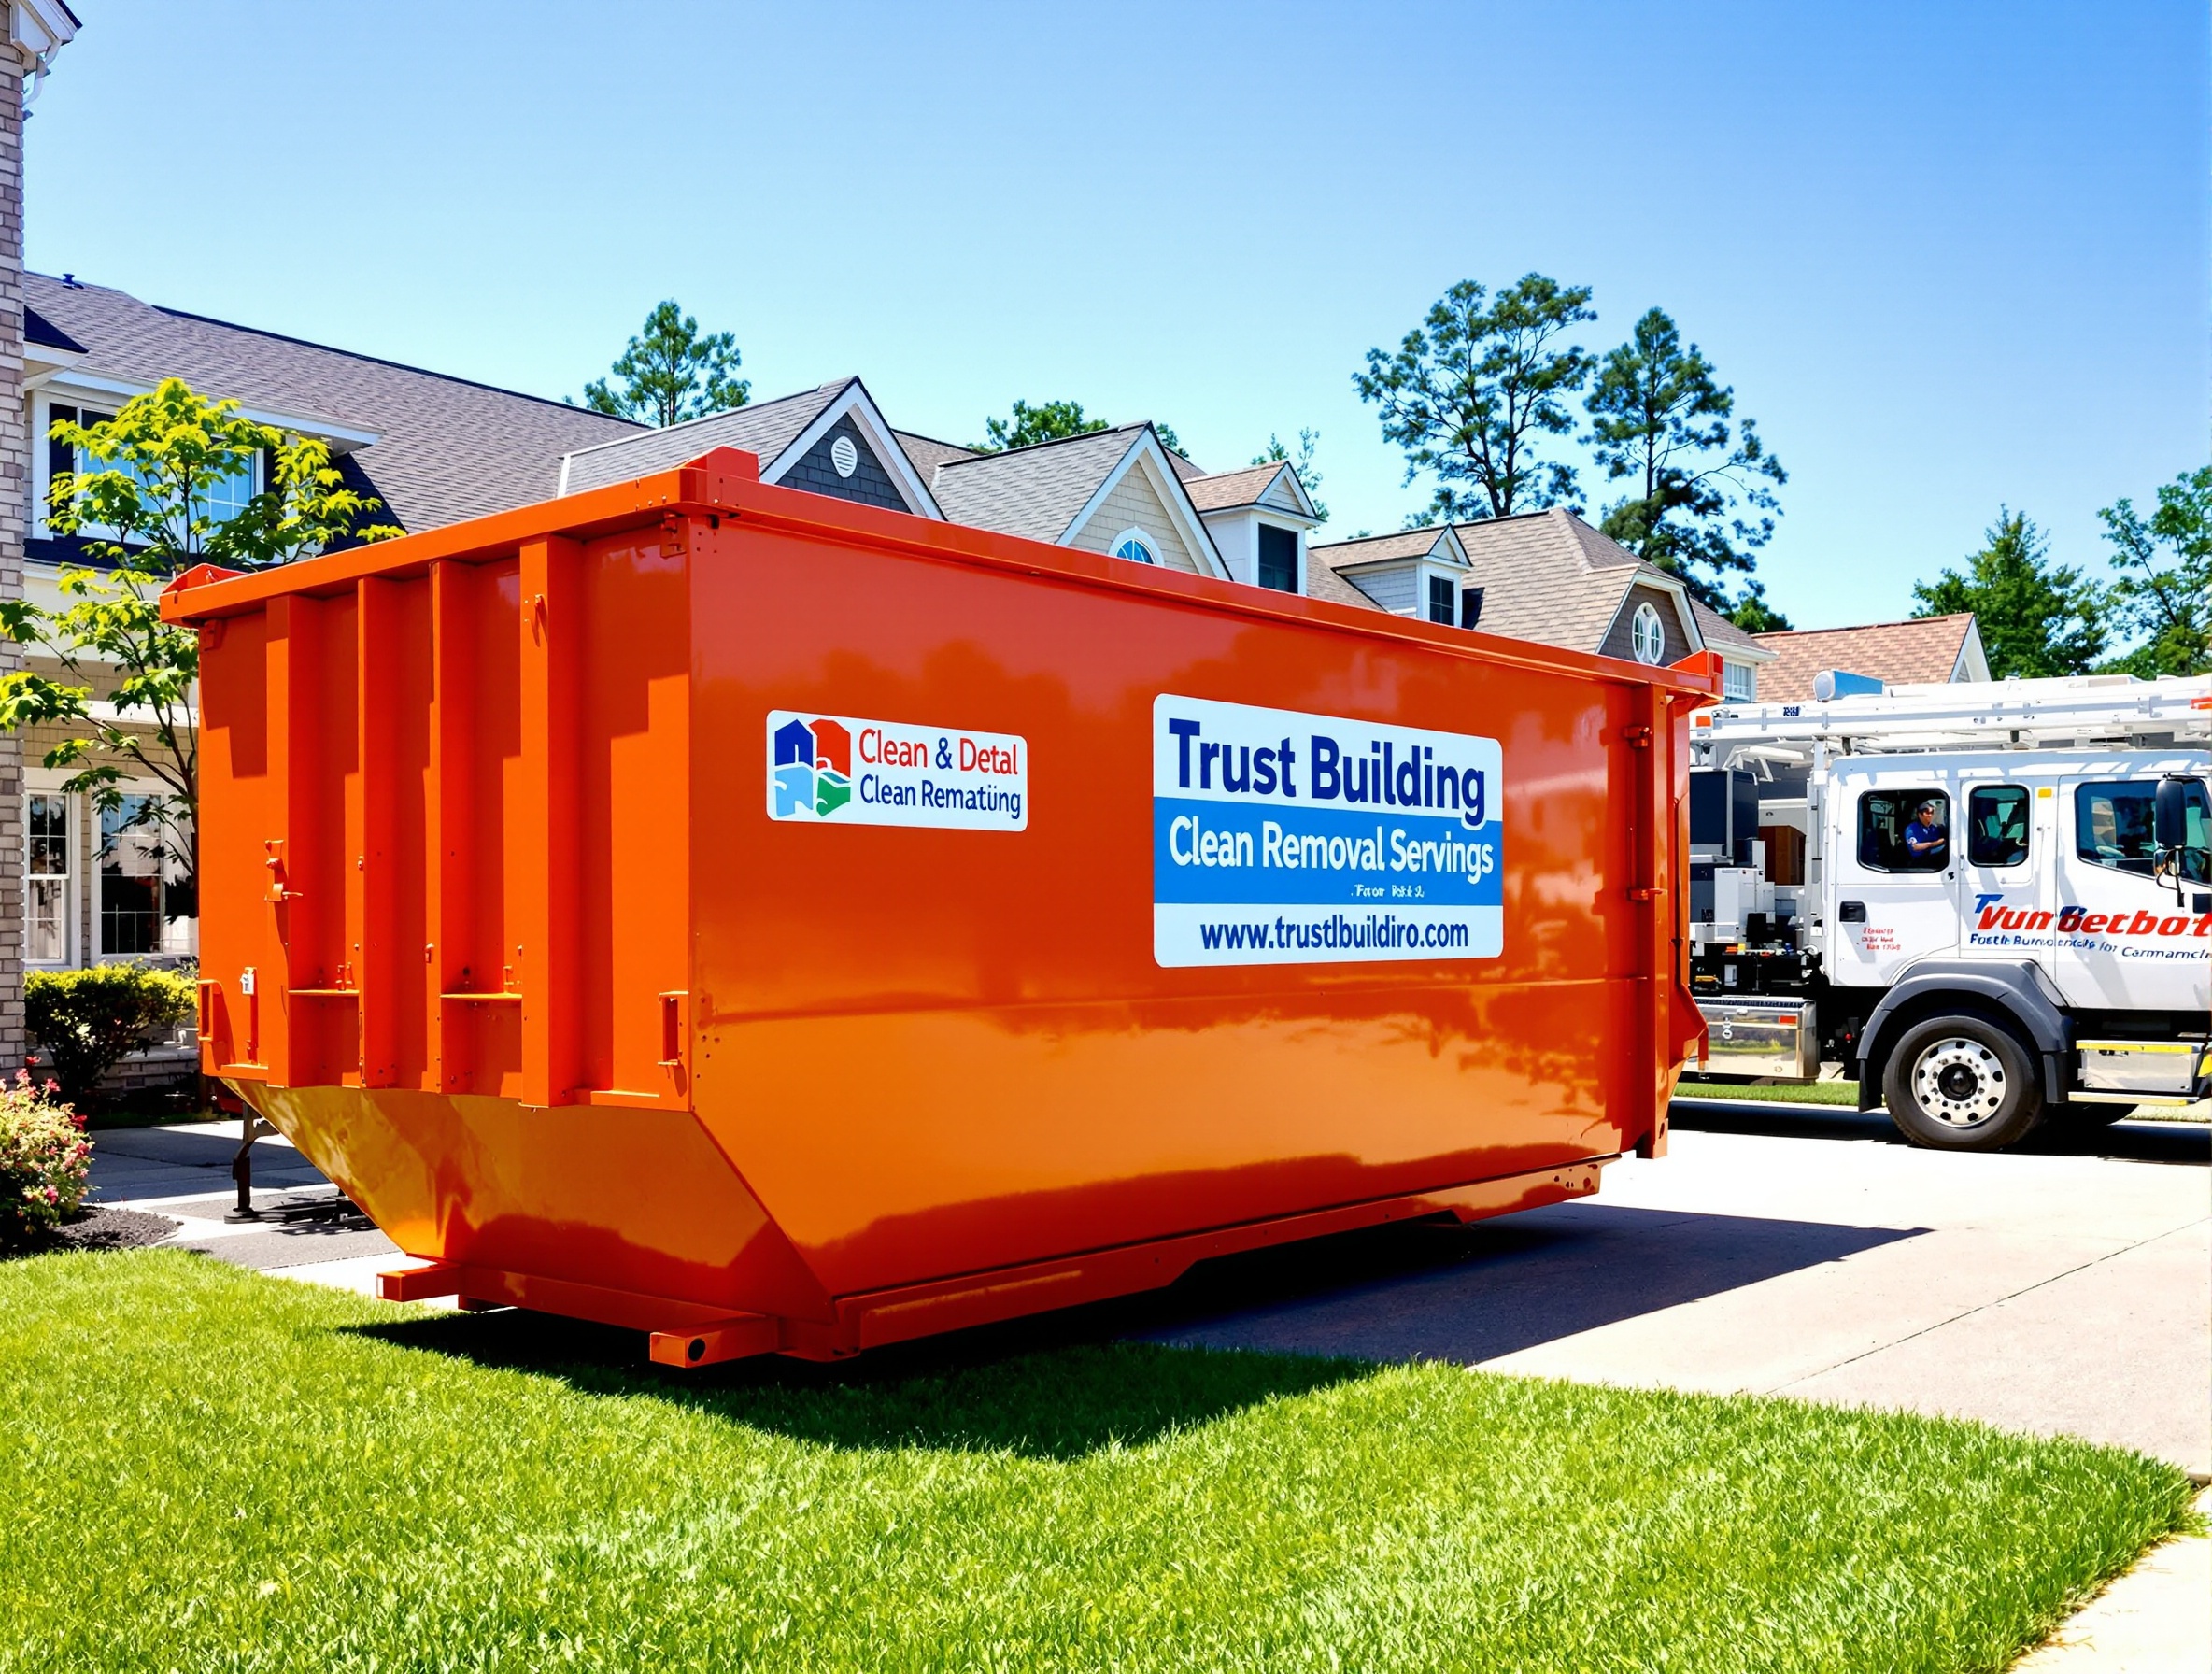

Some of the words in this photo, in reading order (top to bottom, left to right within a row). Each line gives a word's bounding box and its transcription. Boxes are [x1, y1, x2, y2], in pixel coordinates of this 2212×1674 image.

[858, 728, 929, 769] Clean
[935, 736, 954, 770] &
[959, 737, 1019, 775] Detal
[1169, 717, 1297, 798] Trust
[1311, 734, 1486, 827] Building
[859, 773, 916, 807] Clean
[1169, 815, 1254, 868] Clean
[1262, 820, 1385, 872] Removal
[1389, 828, 1495, 885] Servings
